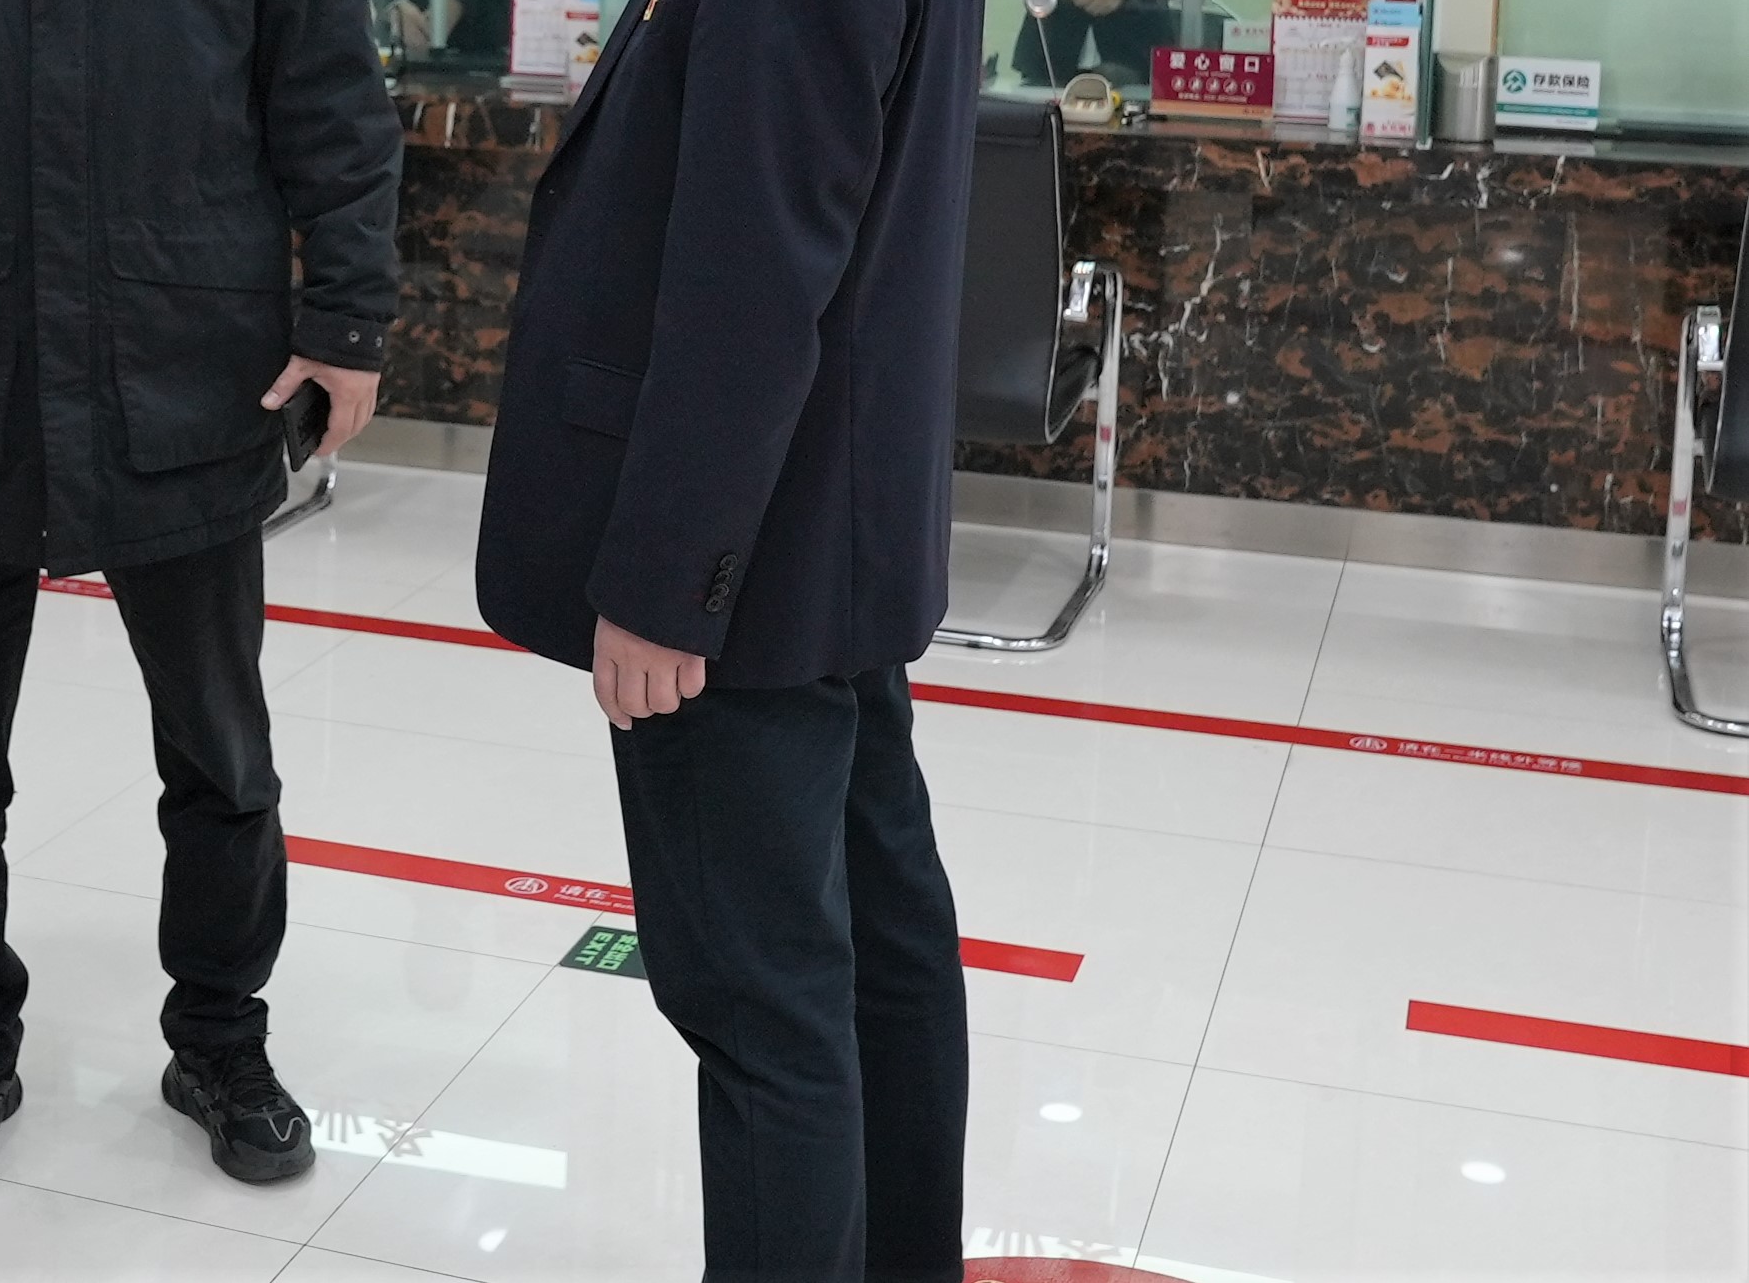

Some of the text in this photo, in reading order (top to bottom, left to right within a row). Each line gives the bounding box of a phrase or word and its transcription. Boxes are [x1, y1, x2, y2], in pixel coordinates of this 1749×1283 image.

[1533, 73, 1590, 89] 存款保险
[574, 931, 615, 966] EXIT
